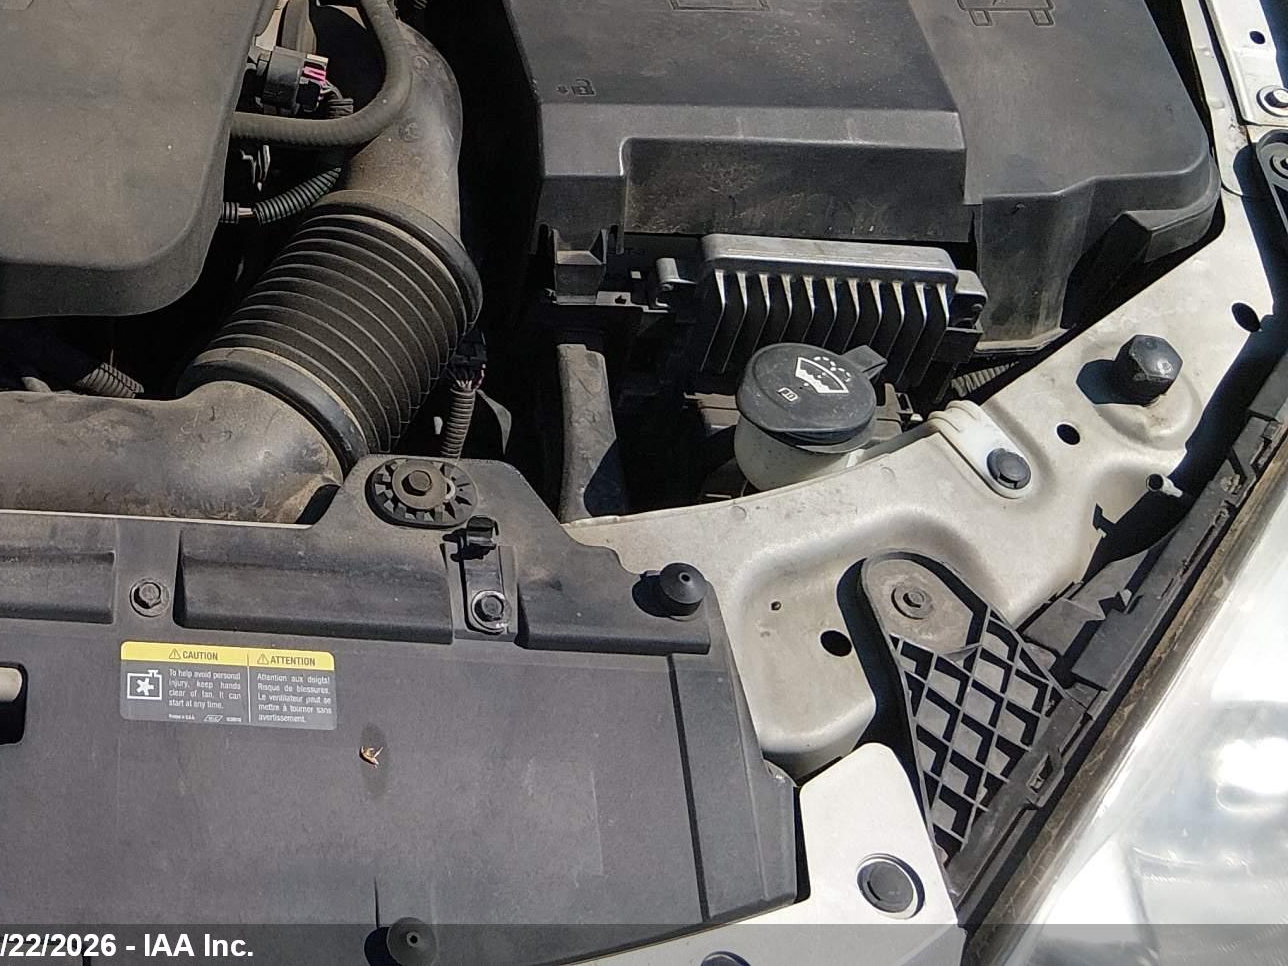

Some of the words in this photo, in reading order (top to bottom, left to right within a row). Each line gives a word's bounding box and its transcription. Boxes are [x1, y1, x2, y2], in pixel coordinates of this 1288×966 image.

[182, 650, 217, 660] CAUTION
[270, 655, 315, 666] ATTENTION
[178, 669, 192, 677] help
[213, 671, 240, 680] personal
[257, 672, 287, 681] Attention
[196, 680, 213, 689] keep
[220, 681, 240, 689] hands
[257, 683, 279, 691] Risque
[168, 688, 185, 696] clear
[190, 689, 197, 697] of
[201, 690, 213, 698] fan.
[168, 698, 183, 706] start
[185, 699, 191, 707] at
[193, 701, 205, 709] any
[258, 692, 266, 700] Le
[268, 693, 302, 702] ventilateur
[305, 695, 320, 705] peut
[258, 703, 279, 711] mettre
[290, 705, 313, 713] tourner
